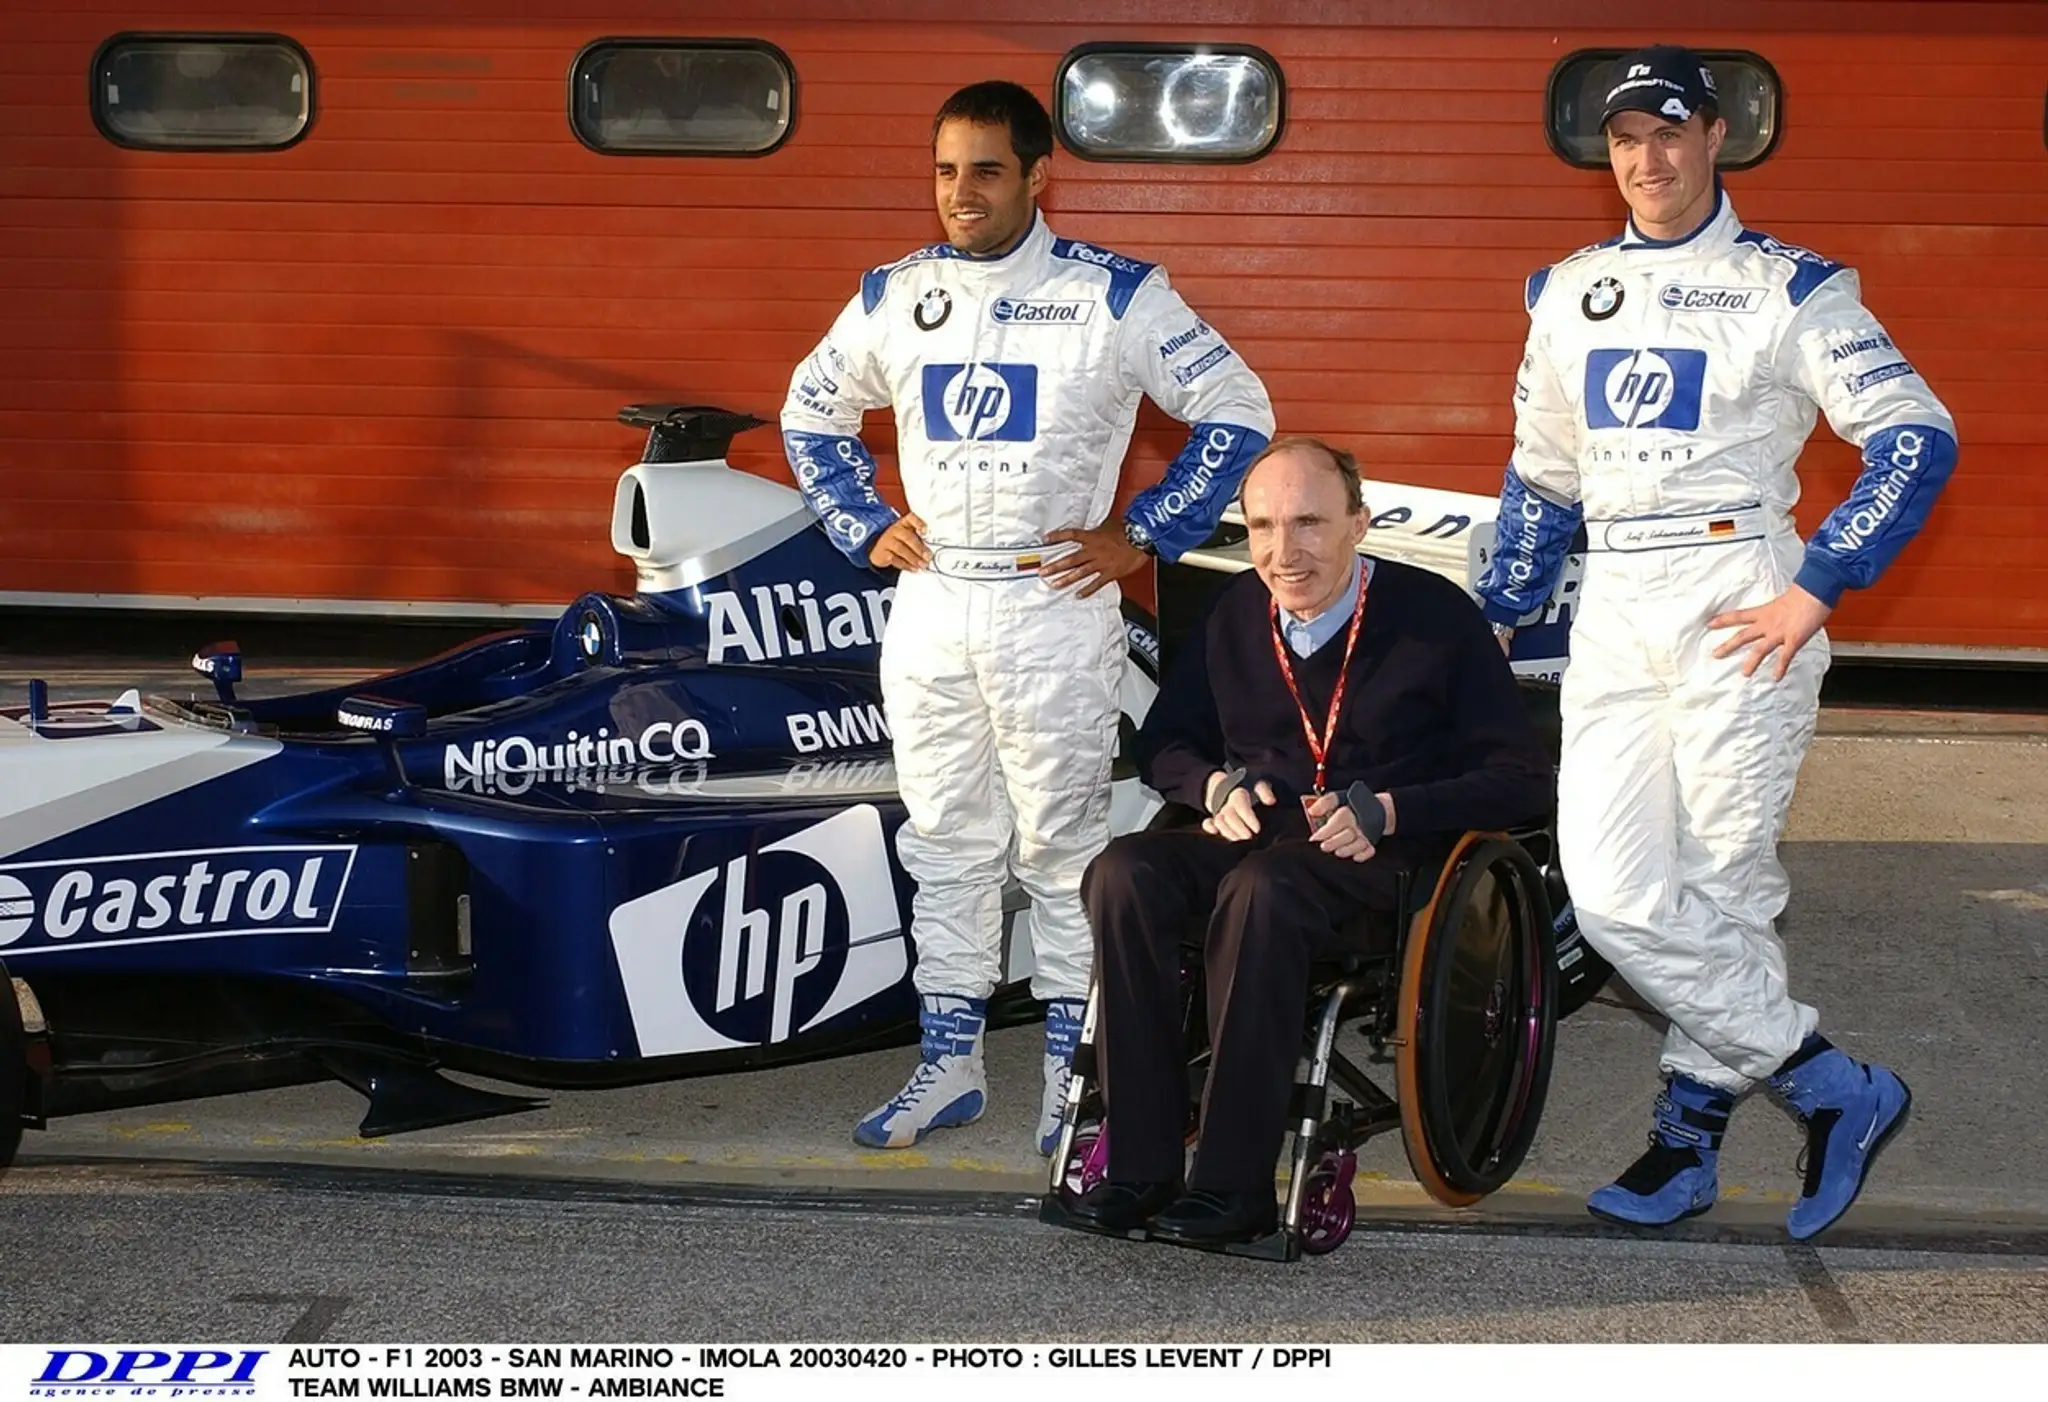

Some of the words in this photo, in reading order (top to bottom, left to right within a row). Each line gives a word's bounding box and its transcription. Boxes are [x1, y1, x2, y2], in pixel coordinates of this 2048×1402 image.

[1013, 303, 1080, 321] Castrol
[1684, 290, 1752, 309] Castrol
[1159, 328, 1199, 359] Allianz
[1832, 339, 1880, 362] Allianz
[954, 363, 1004, 440] hp
[1614, 349, 1668, 428] hp
[1829, 431, 1925, 553] NiQuitinCQ
[703, 580, 897, 664] Allian
[444, 719, 716, 779] NiQuitinCQ
[786, 704, 893, 753] BMW
[44, 857, 323, 938] Castrol
[716, 855, 827, 1044] hp
